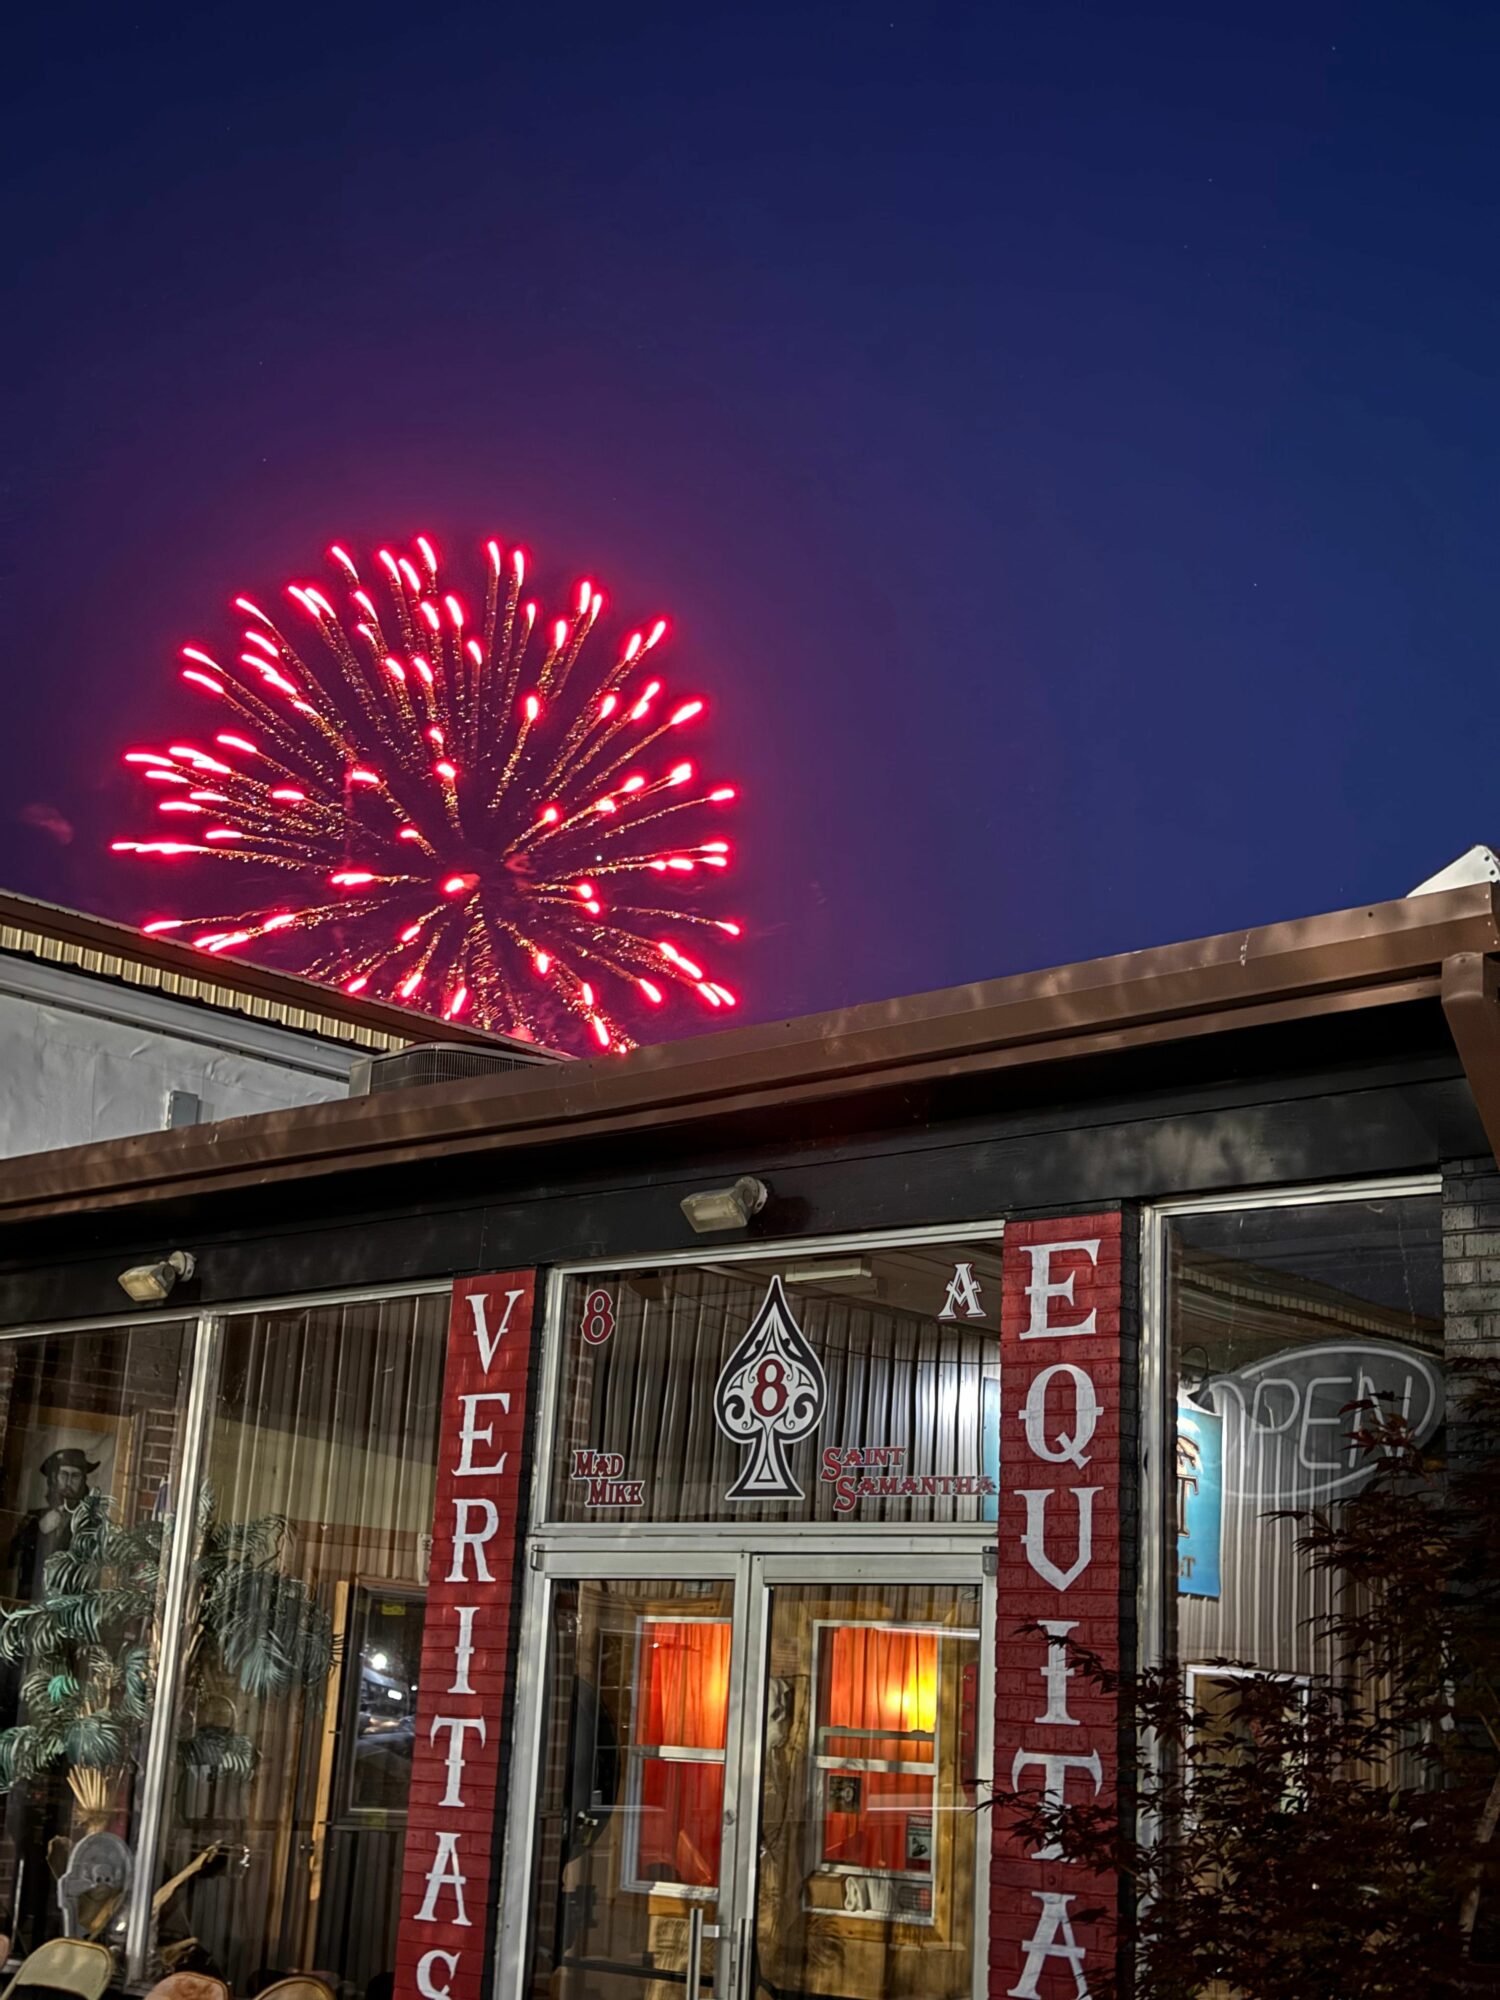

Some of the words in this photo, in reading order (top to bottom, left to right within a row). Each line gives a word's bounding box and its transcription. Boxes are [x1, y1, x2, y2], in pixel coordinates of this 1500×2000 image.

[580, 1289, 616, 1346] 8
[937, 1261, 987, 1320] A
[751, 1357, 790, 1418] 8
[1196, 1366, 1414, 1474] OPEN
